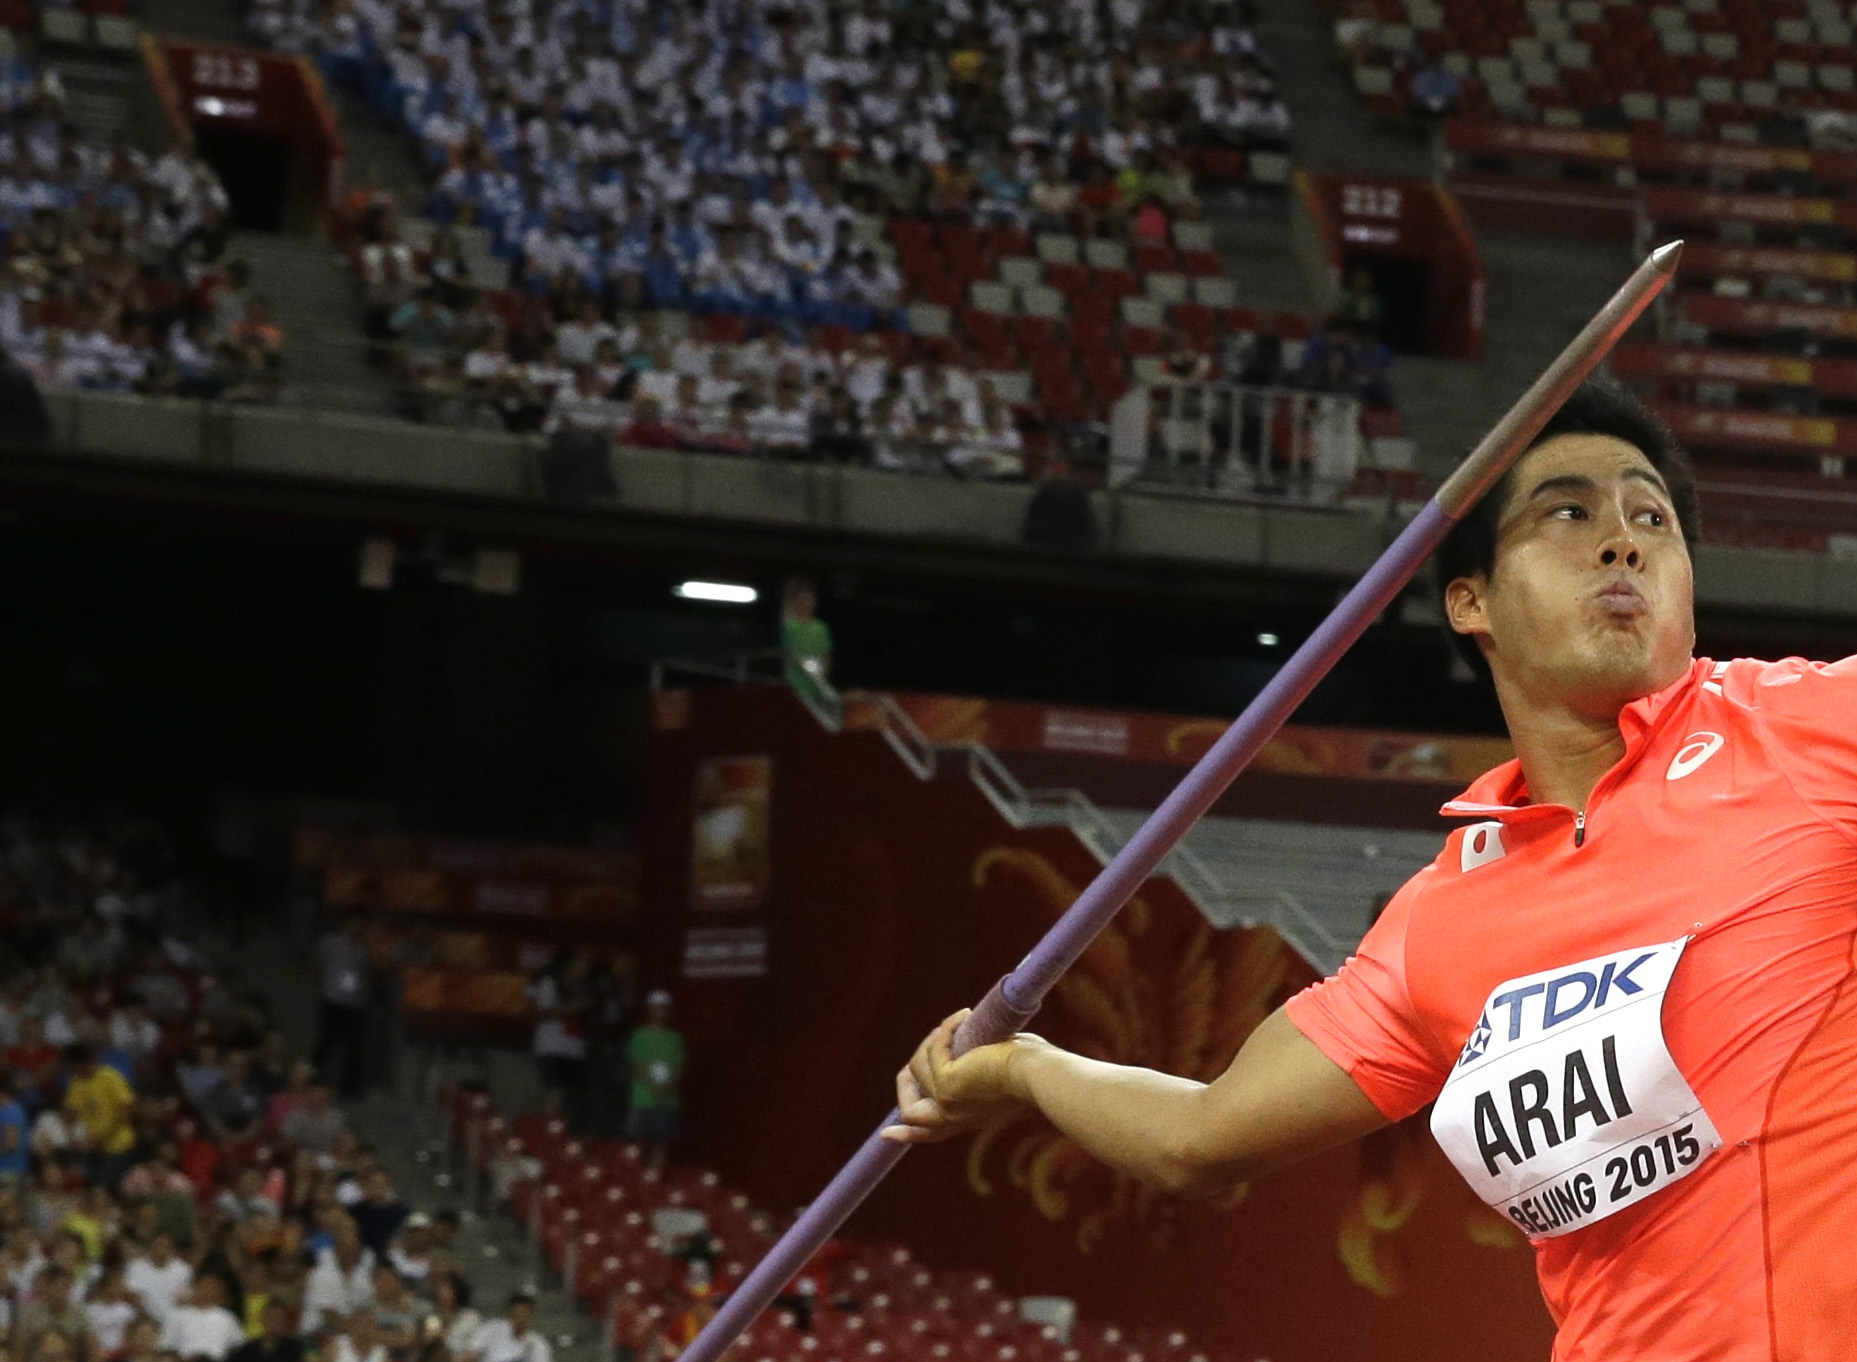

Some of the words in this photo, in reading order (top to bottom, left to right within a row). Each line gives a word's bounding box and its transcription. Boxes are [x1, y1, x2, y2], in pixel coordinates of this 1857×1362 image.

[1492, 951, 1660, 1042] TDK
[1474, 1034, 1634, 1178] ARAI
[1507, 1172, 1597, 1234] BEIJING
[1605, 1122, 1700, 1202] 2015
